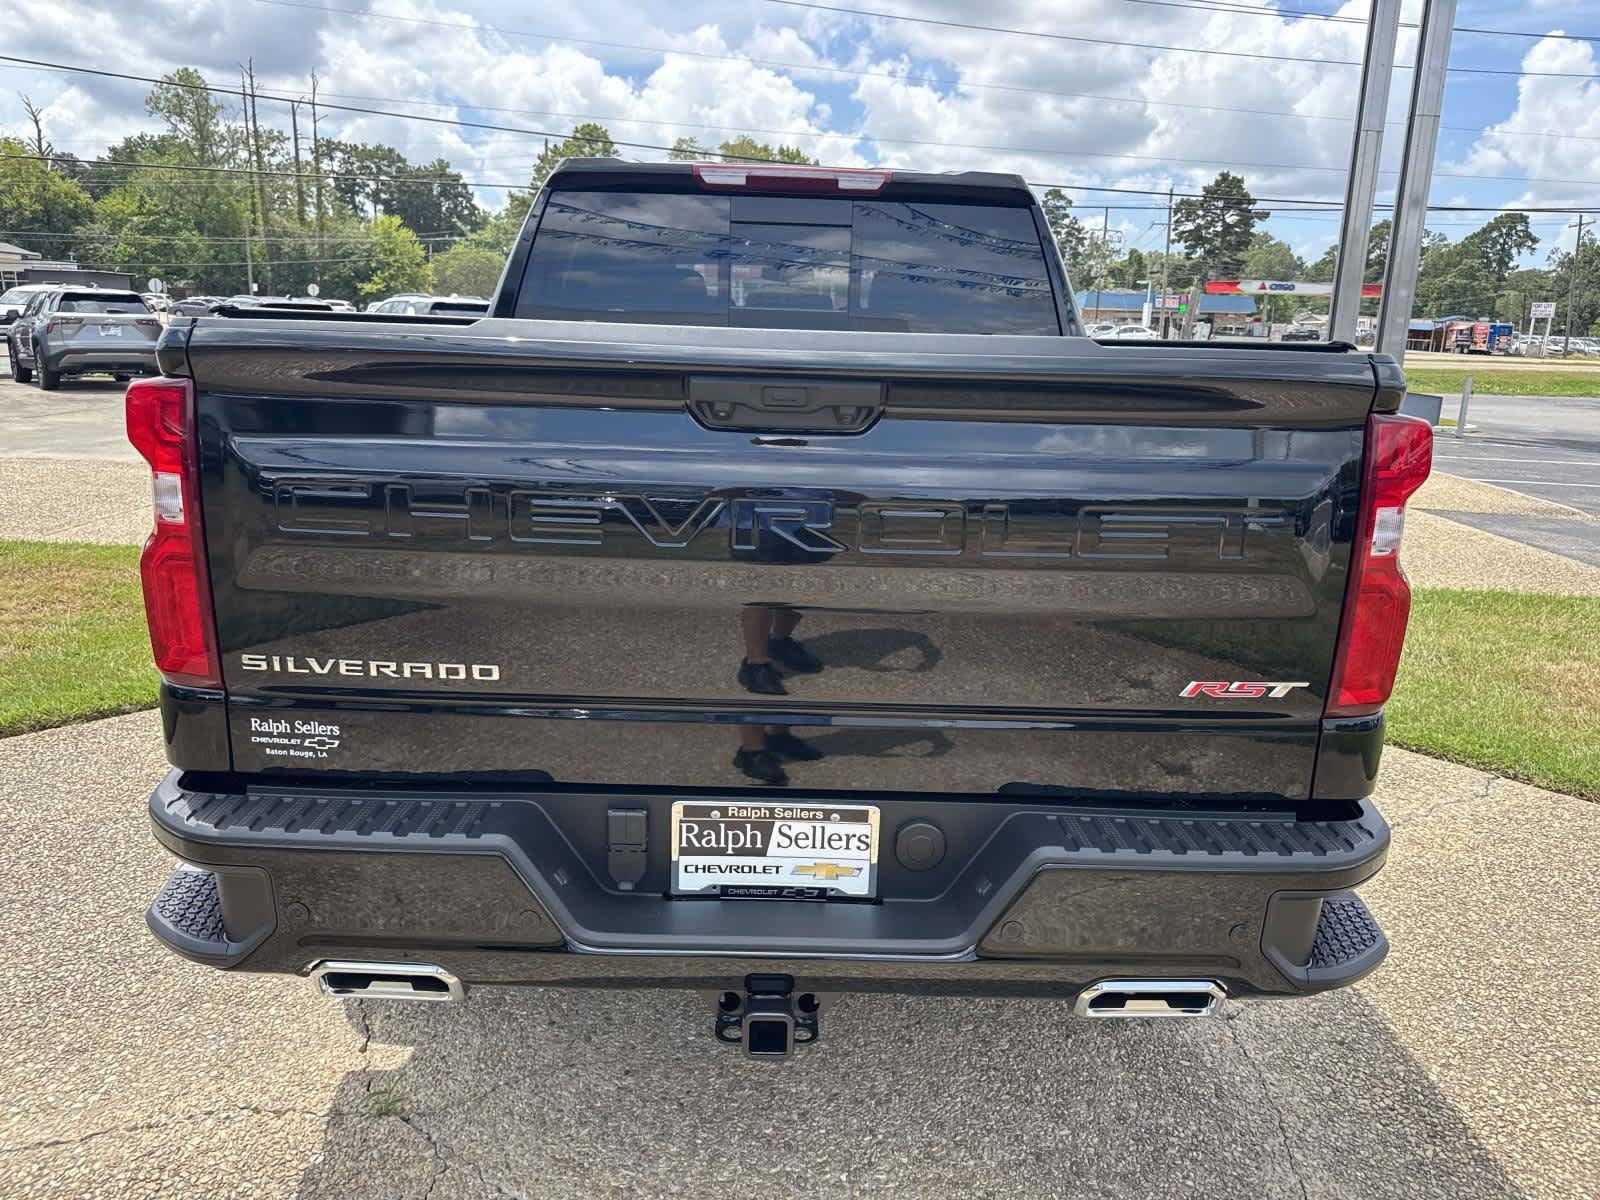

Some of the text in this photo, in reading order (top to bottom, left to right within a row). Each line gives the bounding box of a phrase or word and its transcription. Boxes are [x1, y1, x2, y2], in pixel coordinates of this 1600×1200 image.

[274, 480, 1288, 560] CHEVROLET
[241, 654, 500, 681] SILVERADO
[1178, 681, 1310, 698] RST
[251, 717, 340, 736] Ralph Sellers
[251, 736, 301, 745] CHEVROLET
[265, 747, 288, 756] Baton
[289, 749, 316, 758] Rouge,
[728, 806, 824, 819] Ralph Sellers
[680, 822, 871, 855] Ralph Sellers
[684, 864, 783, 875] CHEVROLET
[728, 888, 778, 896] CHEVROLET
